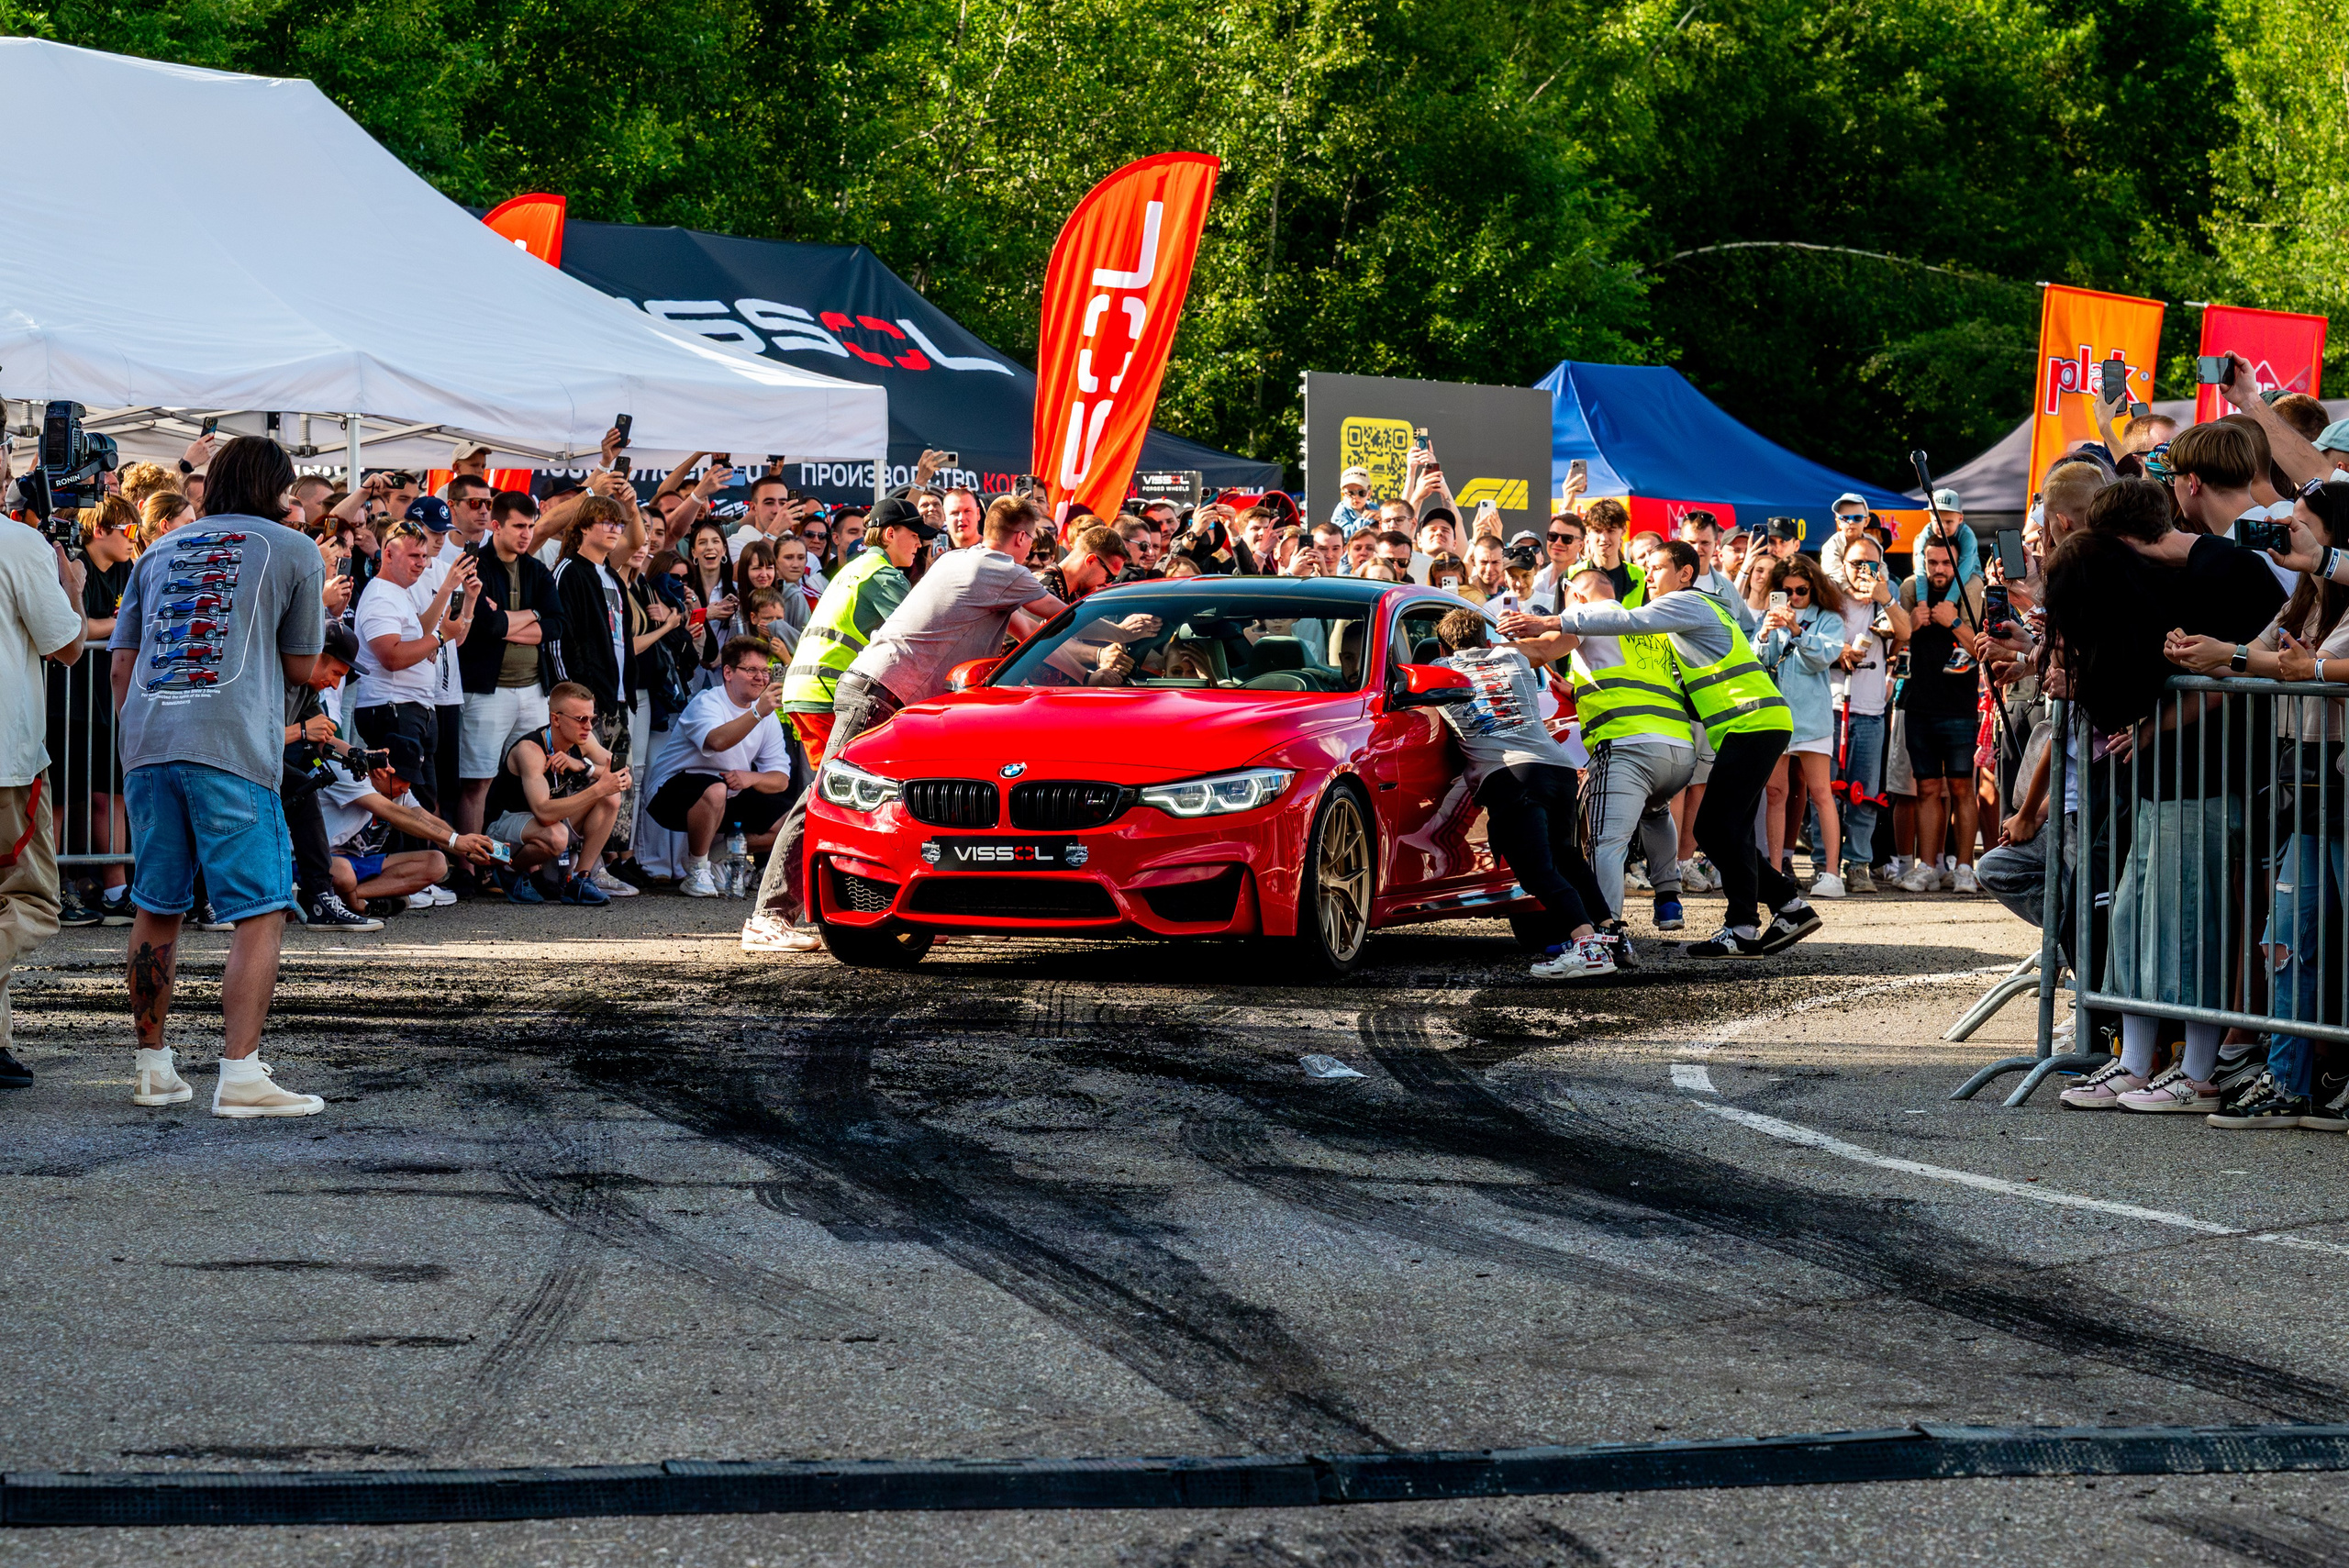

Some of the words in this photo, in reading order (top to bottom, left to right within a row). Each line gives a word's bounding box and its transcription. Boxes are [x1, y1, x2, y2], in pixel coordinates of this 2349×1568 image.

[55, 473, 81, 487] RONIN
[1142, 475, 1190, 485] VISSOL
[1935, 496, 1952, 506] HELLO
[954, 846, 1053, 862] VISSOL
